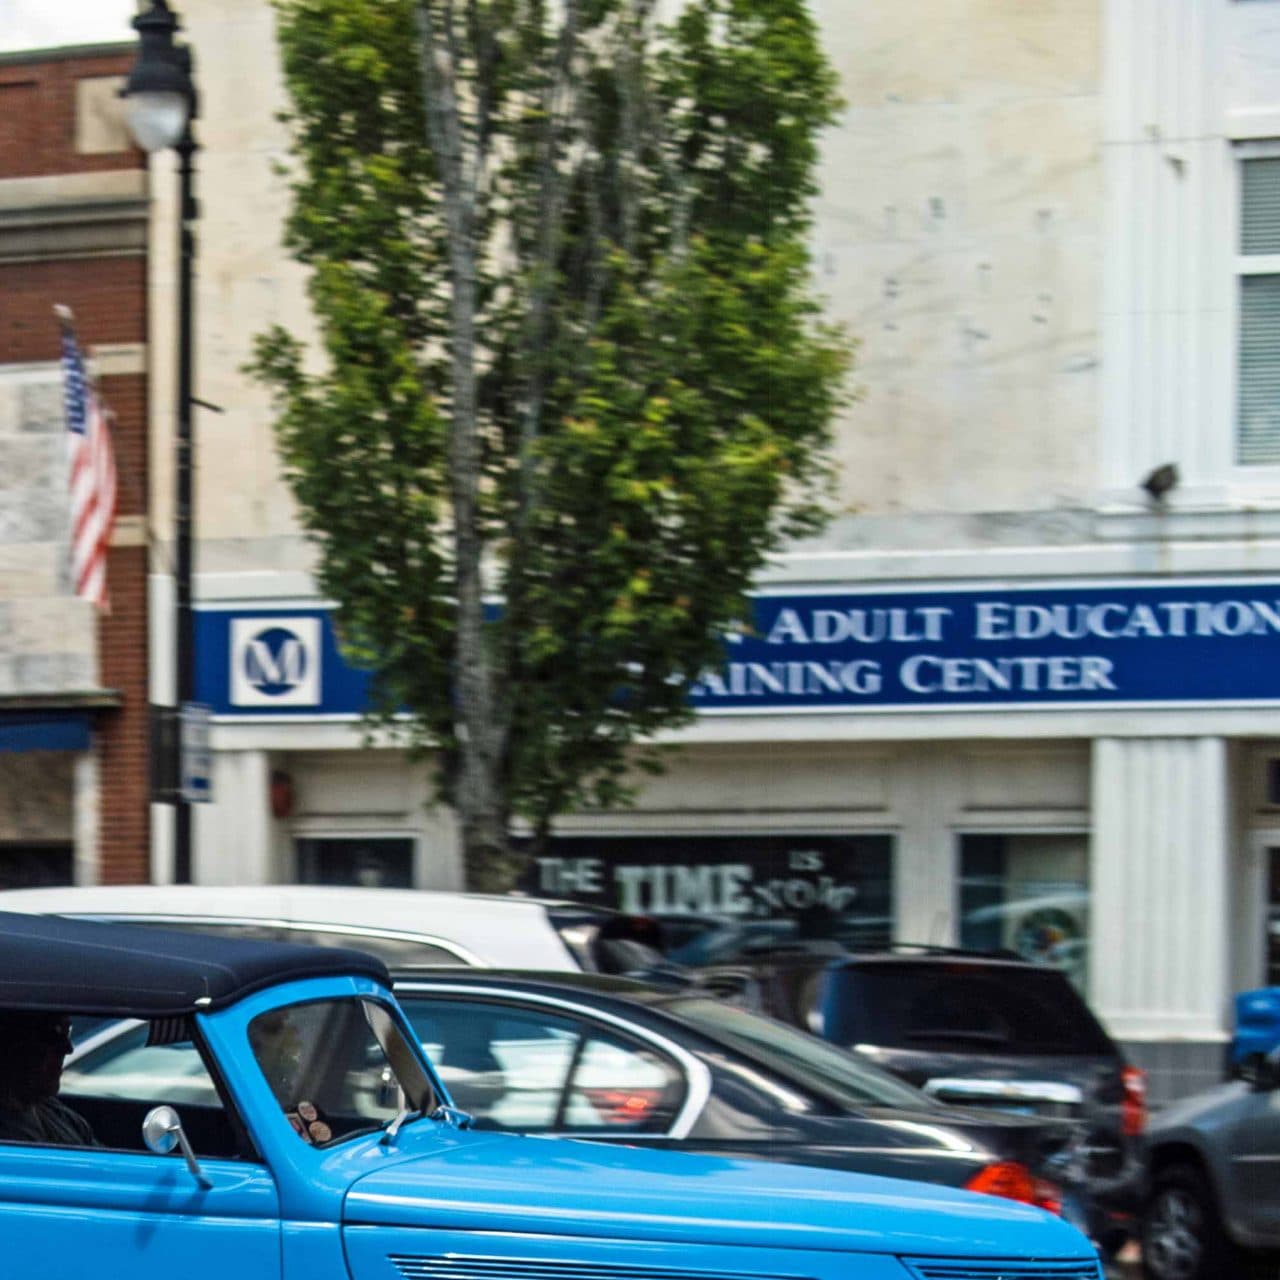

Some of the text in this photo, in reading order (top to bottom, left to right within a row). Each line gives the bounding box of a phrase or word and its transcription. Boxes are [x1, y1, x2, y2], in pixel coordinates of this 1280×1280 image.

[767, 607, 954, 644] ADULT
[974, 600, 1280, 640] EDUCATION
[899, 654, 1119, 693] CENTER
[536, 856, 754, 916] THE TIME
